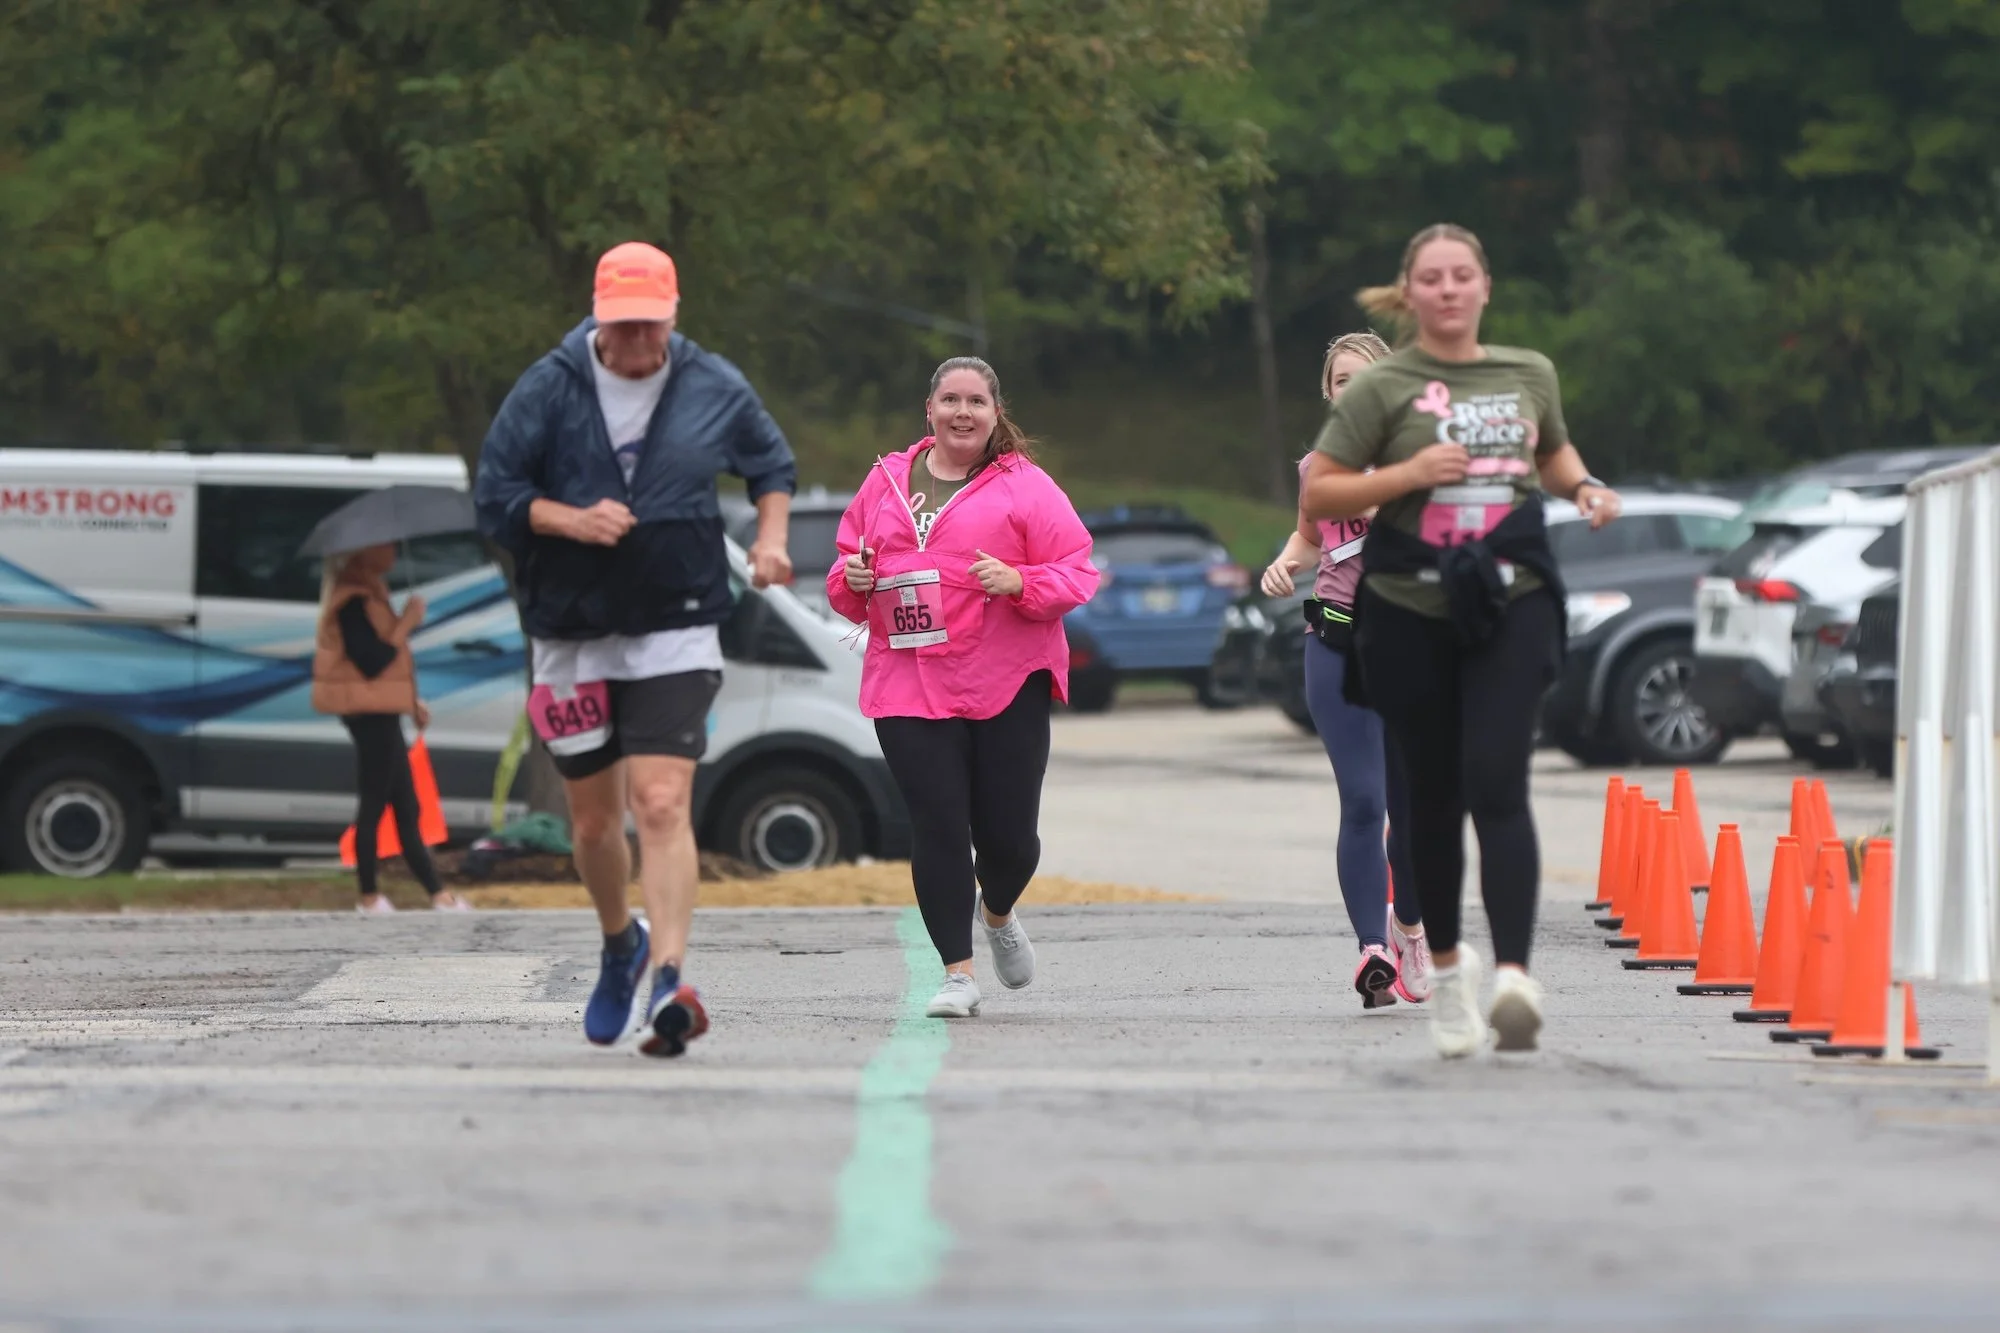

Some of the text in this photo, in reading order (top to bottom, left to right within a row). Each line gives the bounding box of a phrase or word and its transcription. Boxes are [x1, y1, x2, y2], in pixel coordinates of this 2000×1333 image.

[1452, 402, 1519, 426] Race
[1436, 418, 1525, 445] Grace
[0, 488, 176, 517] MSTRONG
[893, 604, 932, 632] 655
[544, 694, 602, 737] 649
